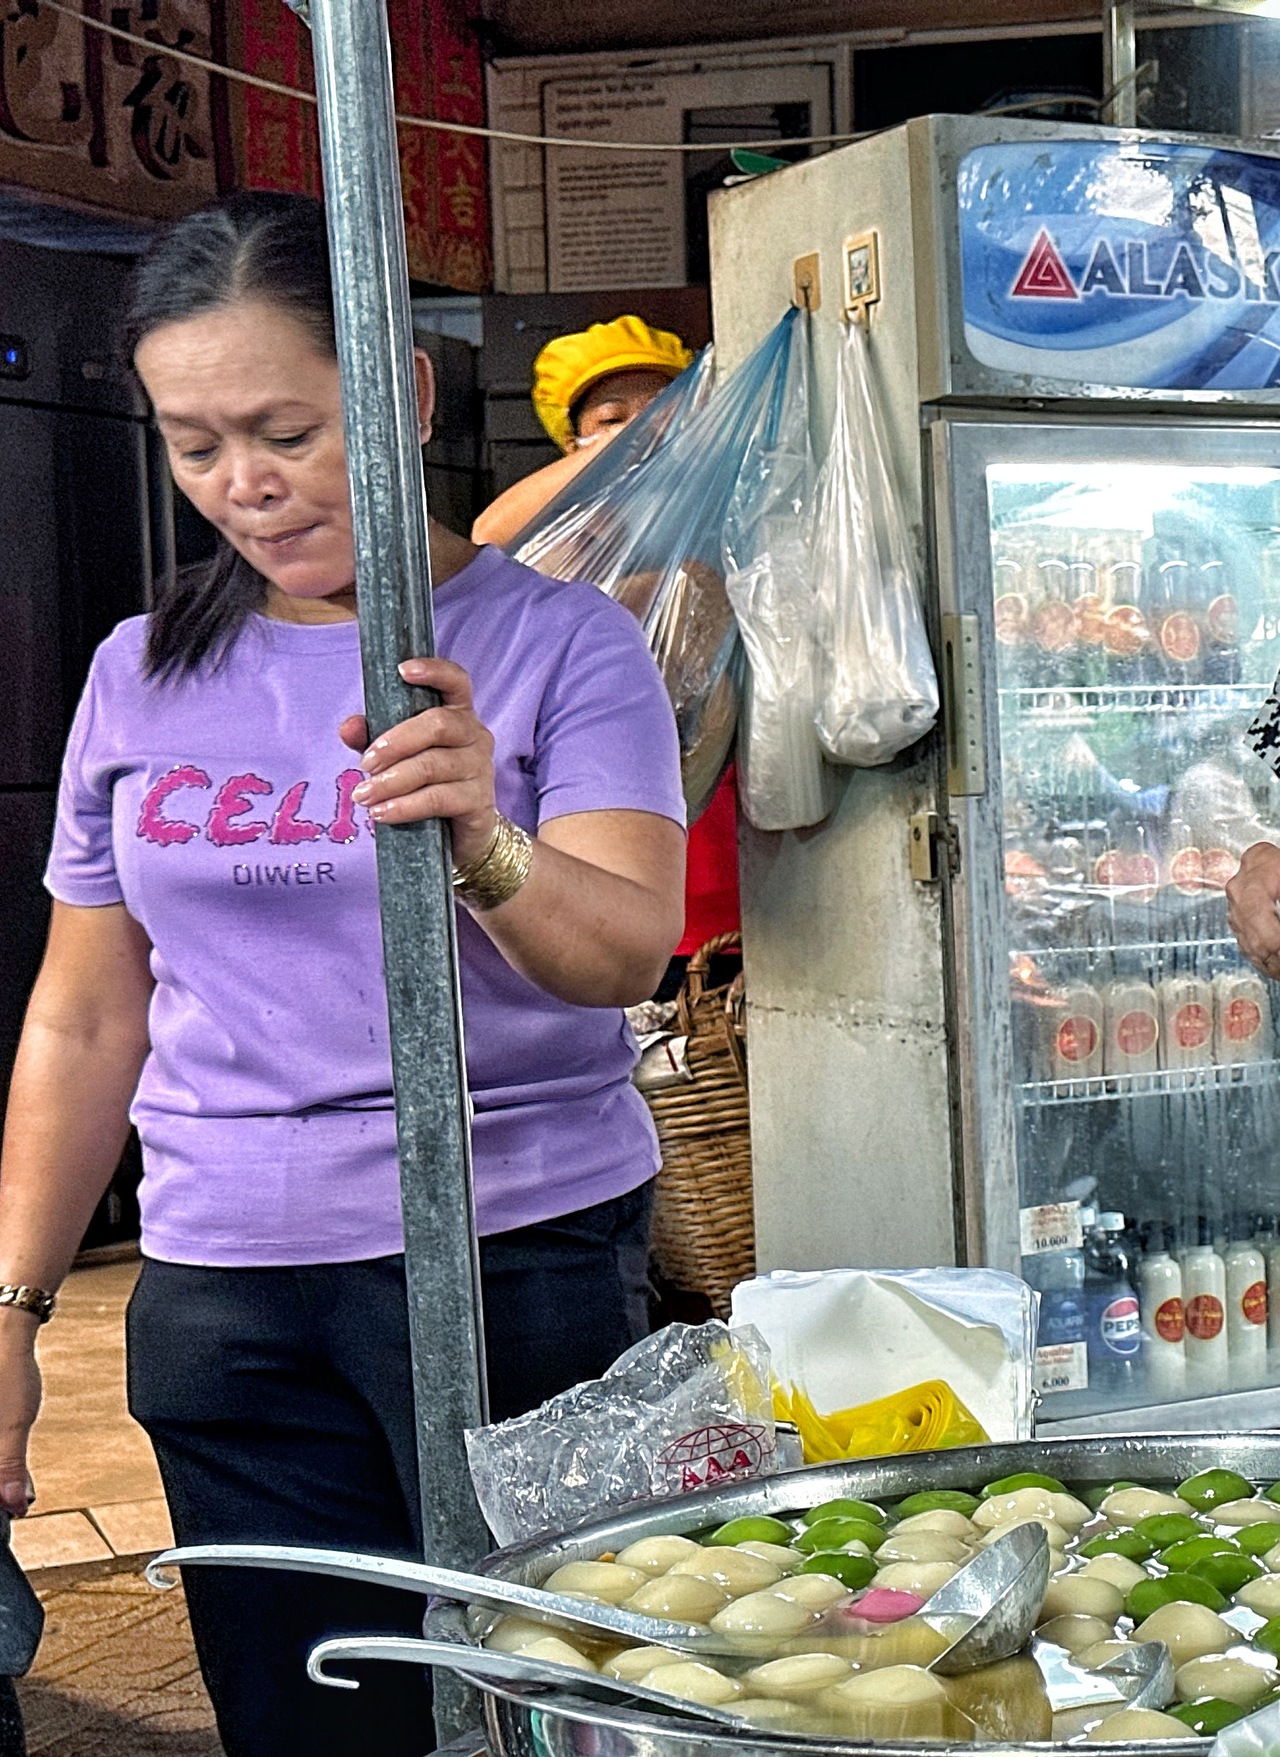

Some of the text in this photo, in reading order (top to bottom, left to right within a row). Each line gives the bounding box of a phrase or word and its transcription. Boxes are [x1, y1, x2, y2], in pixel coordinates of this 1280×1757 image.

[137, 765, 375, 847] CELI
[1033, 1235, 1068, 1249] 10.000
[1104, 1317, 1139, 1333] PEPS
[682, 1449, 754, 1492] AAA
